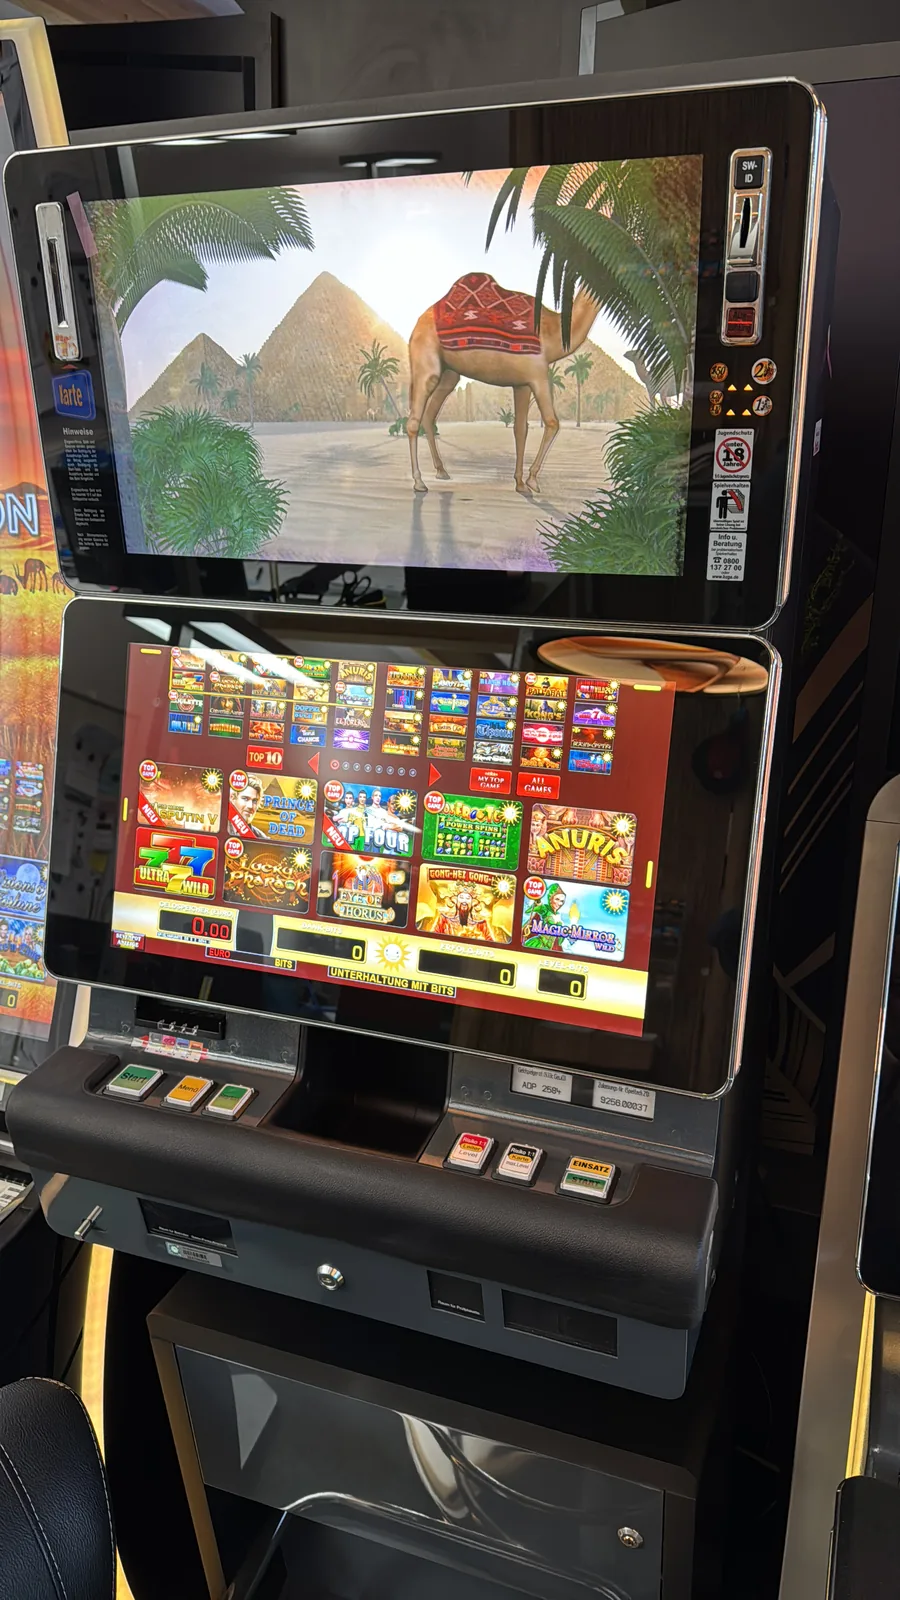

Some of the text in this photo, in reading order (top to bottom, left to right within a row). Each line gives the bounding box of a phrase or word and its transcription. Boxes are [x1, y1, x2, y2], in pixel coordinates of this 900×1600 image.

[742, 160, 758, 170] SW-
[744, 173, 753, 183] ID
[62, 427, 94, 436] Hinweise
[722, 447, 745, 462] 18
[0, 493, 39, 535] N
[713, 540, 742, 548] Beratung
[249, 751, 282, 766] TOP 10
[233, 774, 246, 782] TOP
[524, 784, 552, 794] GAMES
[264, 795, 315, 813] PRINCE
[428, 795, 442, 803] TOP
[141, 803, 159, 823] NEU
[207, 813, 219, 825] V
[279, 811, 297, 823] OF
[231, 815, 249, 834] NEU
[268, 822, 305, 838] DEAD
[446, 820, 499, 833] POWER SPINS
[327, 825, 345, 847] NEU
[365, 826, 410, 853] FOUR
[229, 841, 241, 849] TOP
[535, 828, 629, 865] ANURIS
[139, 865, 170, 882] ULTRA
[181, 880, 210, 896] WILD
[528, 880, 543, 889] TOP
[527, 888, 543, 896] GAME
[344, 905, 384, 920] HORUS
[191, 916, 230, 939] 0.00
[301, 921, 343, 935] BANK-BITS
[208, 947, 231, 958] EURO
[351, 945, 363, 960] 0
[274, 958, 293, 969] BITS
[538, 959, 589, 973] LEVEL-BITS
[330, 967, 454, 996] UNTERHALTUNG MIT BITS
[499, 969, 511, 984] 0
[569, 980, 582, 996] 0
[7, 994, 16, 1008] 0
[120, 1072, 148, 1083] Start
[522, 1081, 537, 1090] ADP
[463, 1136, 479, 1145] Risiko
[511, 1147, 527, 1156] Risiko
[572, 1160, 611, 1173] EINSATZ
[571, 1176, 602, 1187] START
